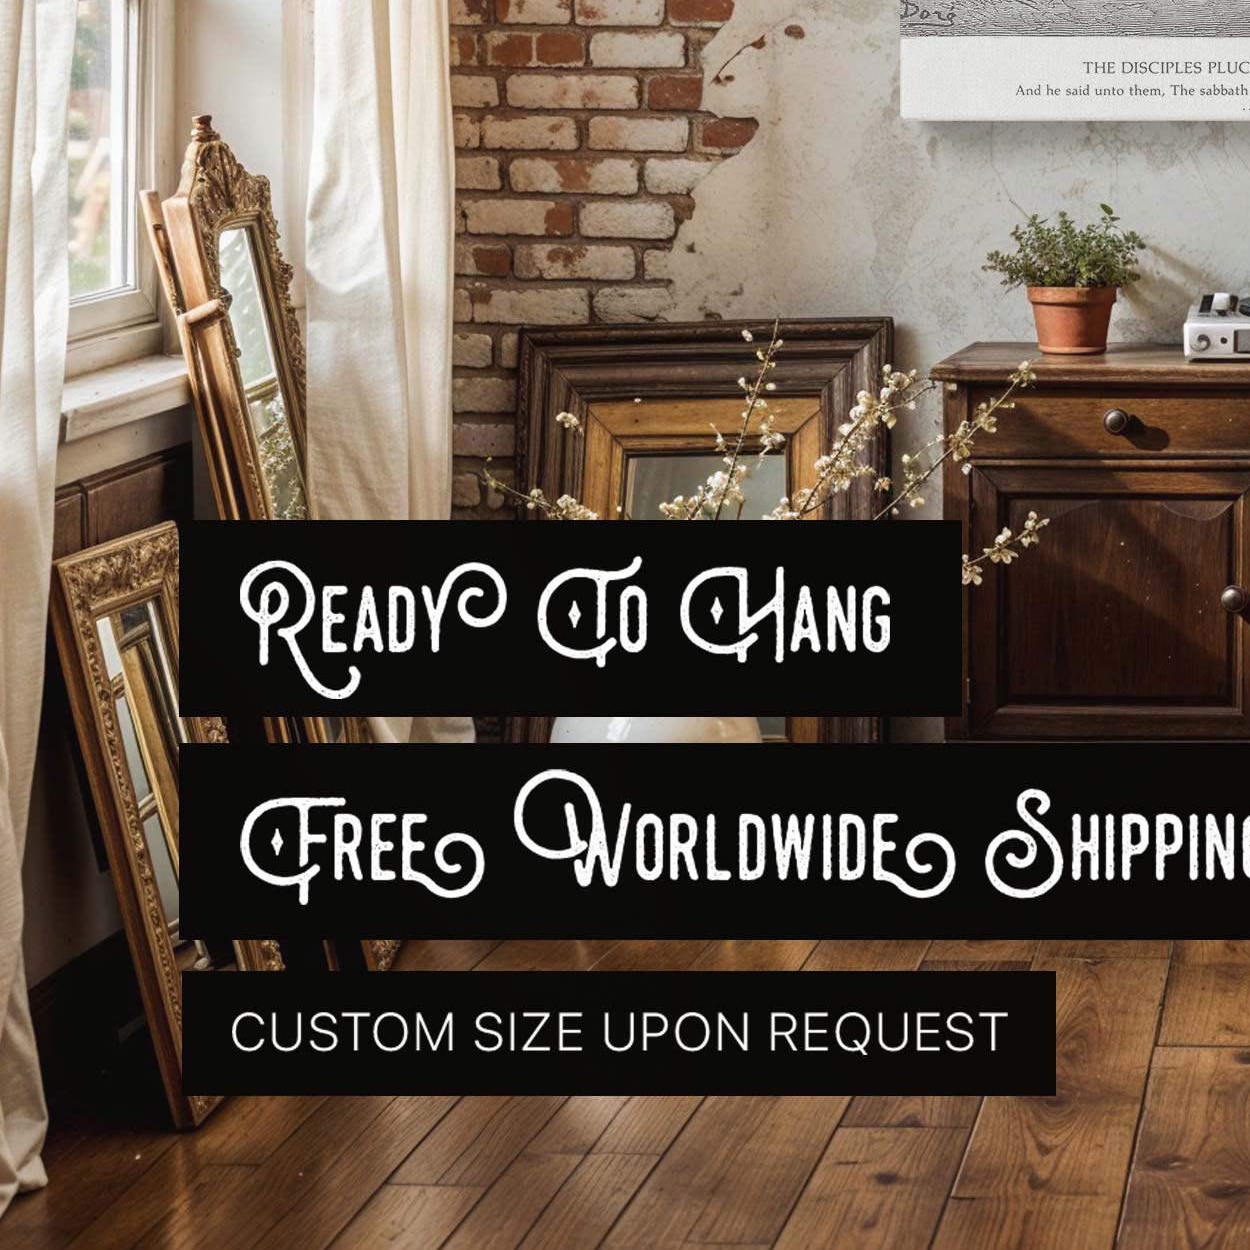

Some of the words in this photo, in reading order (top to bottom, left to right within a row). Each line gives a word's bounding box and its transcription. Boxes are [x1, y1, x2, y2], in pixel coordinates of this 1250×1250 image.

[1082, 61, 1116, 74] THE
[1121, 61, 1202, 75] DISCIPLES
[1015, 84, 1041, 96] And
[1046, 84, 1061, 96] he
[1065, 84, 1090, 96] said
[1095, 86, 1125, 96] unto
[1129, 83, 1165, 98] them,
[1169, 83, 1196, 96] The
[1199, 83, 1249, 96] sabbath
